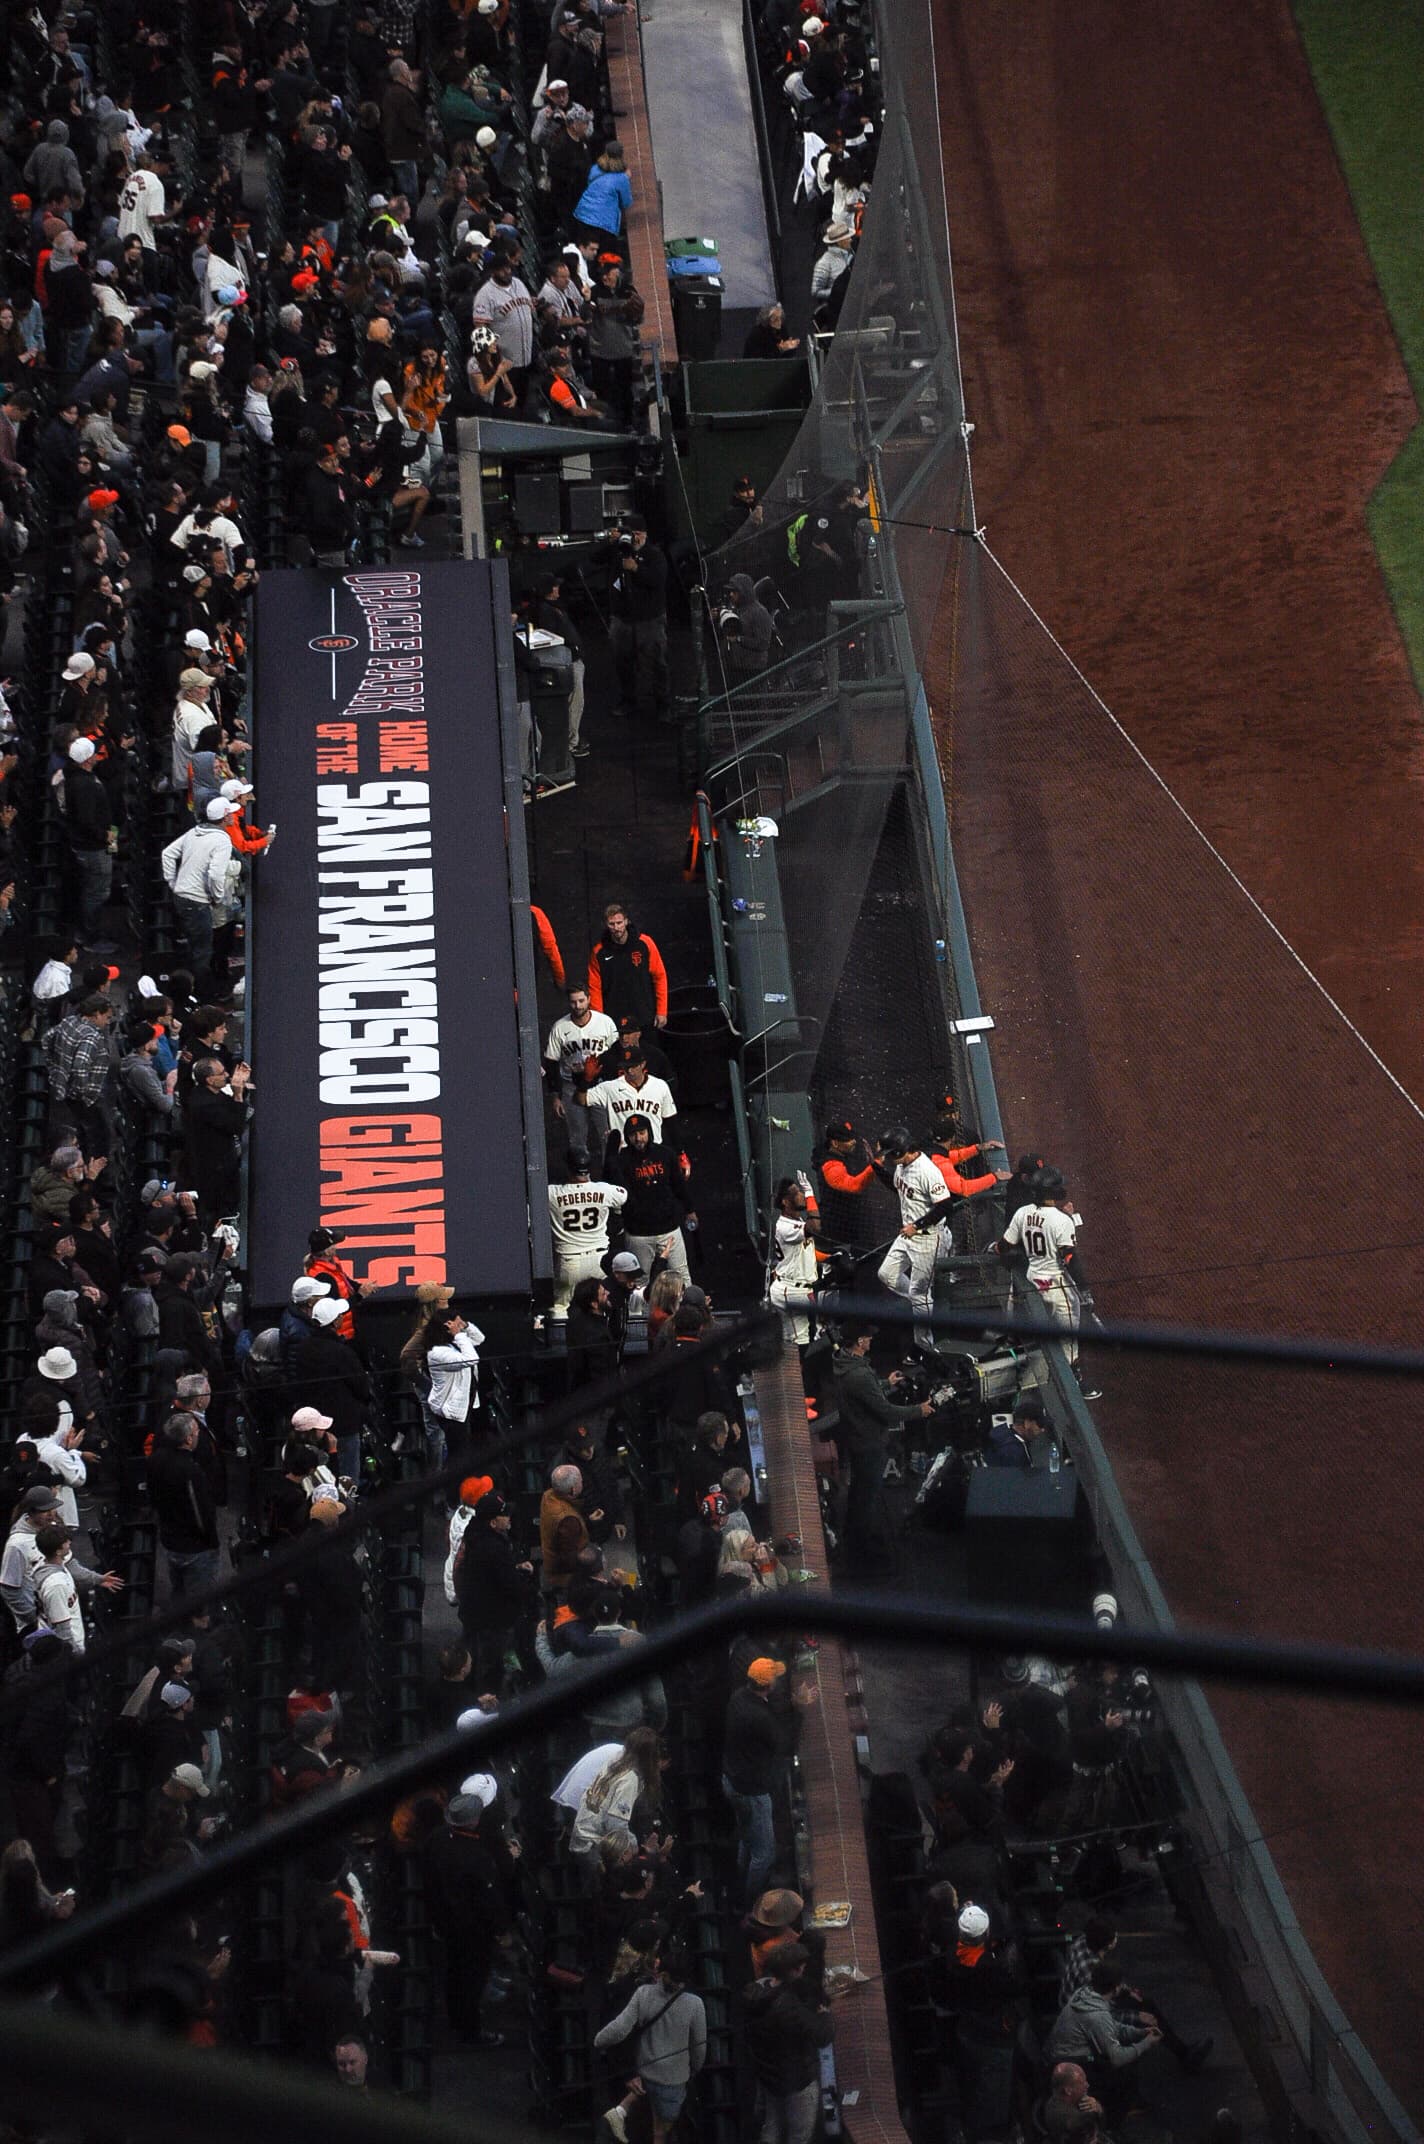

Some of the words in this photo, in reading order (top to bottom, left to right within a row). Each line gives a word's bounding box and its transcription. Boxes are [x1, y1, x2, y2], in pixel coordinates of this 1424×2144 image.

[342, 571, 422, 651] ORACLE
[342, 656, 425, 715] PARK
[316, 722, 358, 741] OF
[316, 744, 359, 775] THE
[378, 720, 430, 773] HOME
[316, 780, 433, 863] SAN
[317, 868, 441, 1105] FRANCISCO
[561, 1038, 604, 1056] GIANTS
[612, 1099, 660, 1115] GIANTS
[319, 1113, 447, 1288] GIANTS
[556, 1192, 605, 1207] PEDERSON
[562, 1207, 600, 1231] 23
[1026, 1212, 1045, 1229] DÍAZ
[1025, 1230, 1047, 1257] 10
